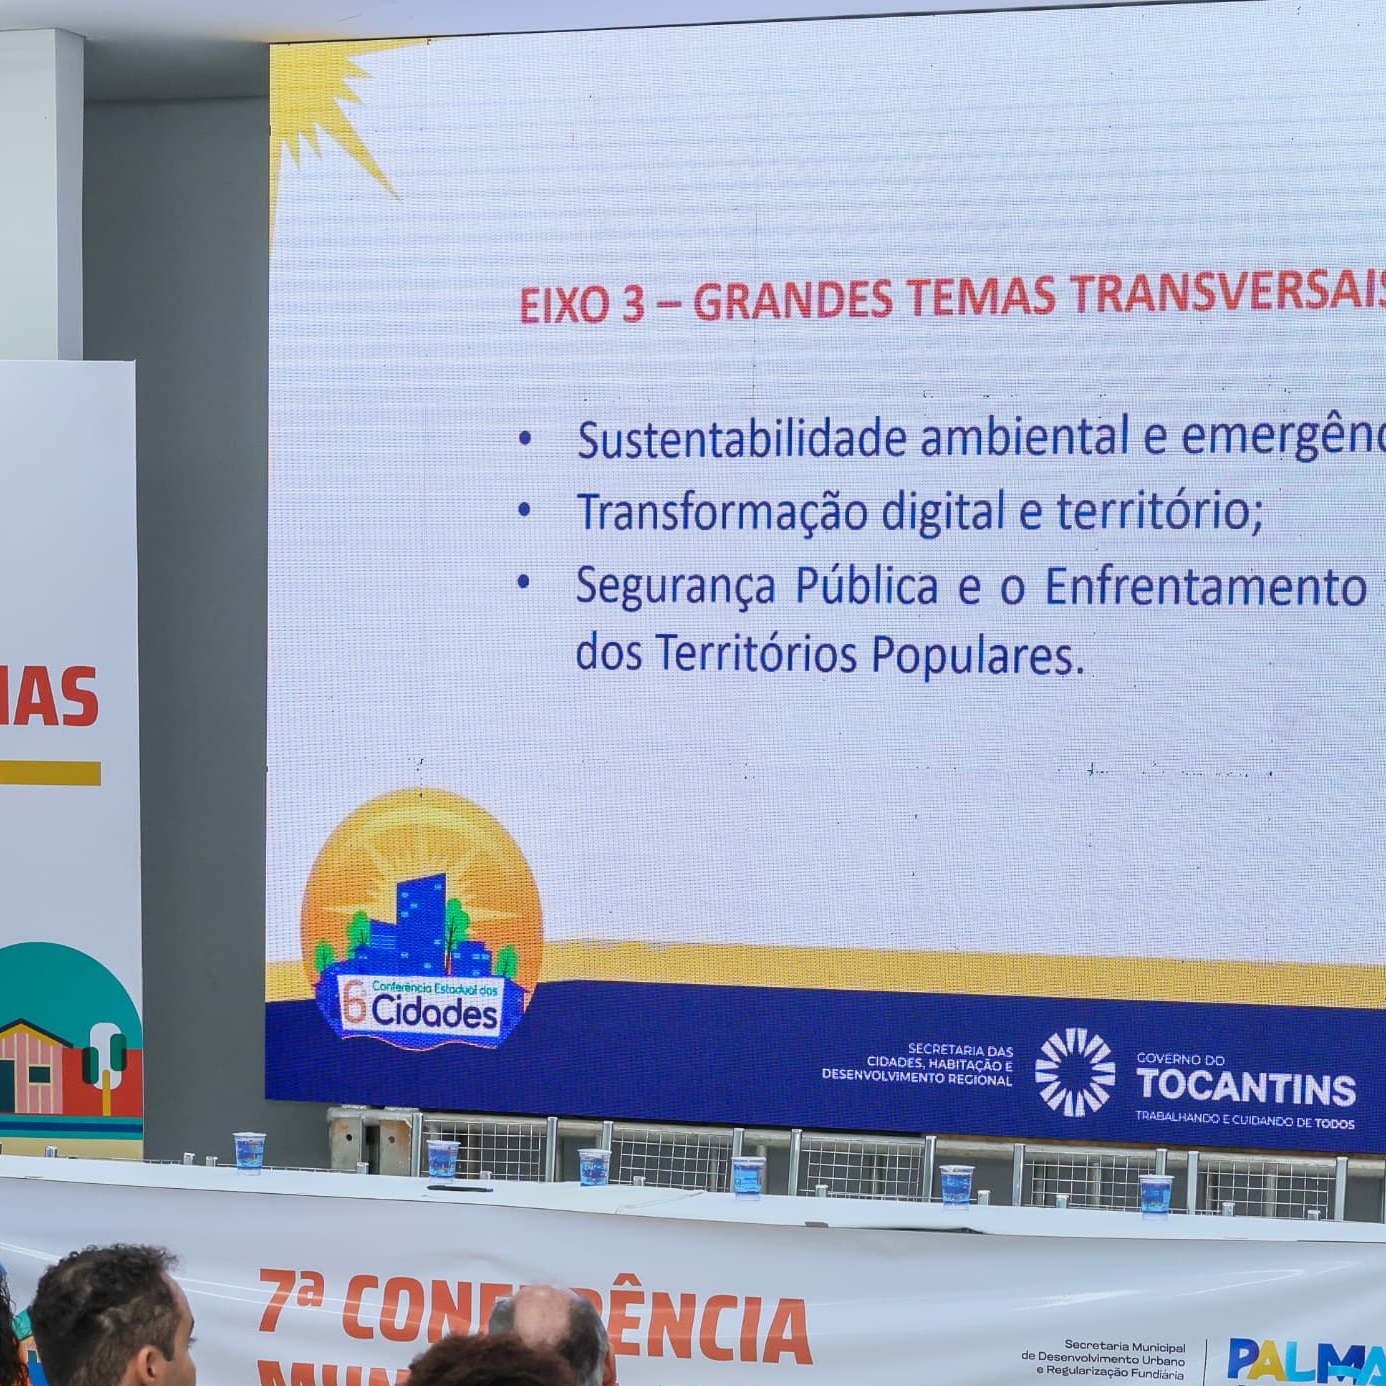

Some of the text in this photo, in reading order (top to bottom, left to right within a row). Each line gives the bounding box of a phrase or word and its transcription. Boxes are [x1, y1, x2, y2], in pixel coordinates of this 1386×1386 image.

[520, 286, 610, 324] EIXO
[623, 284, 645, 323] 3
[693, 279, 893, 321] GRANDES
[907, 275, 1056, 316] TEMAS
[578, 416, 907, 459] Sustentabilidade
[921, 413, 1129, 456] ambiental
[1144, 424, 1168, 454] e
[576, 487, 1263, 540] Transformação digital e território;
[577, 565, 775, 613] Segurança
[797, 563, 938, 605] Pública
[959, 574, 981, 605] e
[1001, 575, 1025, 606] o
[1047, 562, 1367, 607] Enfrentamento
[576, 630, 1084, 683] dos Territórios Populares.
[435, 982, 478, 995] Estadual
[480, 985, 498, 996] dos
[372, 993, 498, 1030] Cidades
[909, 1043, 1013, 1057] SECRETARIA DAS
[1137, 1053, 1225, 1066] GOVERNO DO
[867, 1056, 1013, 1072] CIDADES, HABITAÇÃO E
[822, 1068, 1013, 1087] DESENVOLVIMENTO REGIONAL
[1136, 1068, 1356, 1107] TOCANTINS
[1136, 1110, 1355, 1130] TRABALHANDO E CUIDANDO DE TODOS
[258, 1268, 324, 1333] 7ª
[1065, 1340, 1186, 1355] Secretaria Municipal
[1021, 1350, 1185, 1367] de Desenvolvimento Urbano
[1037, 1365, 1185, 1381] e Regularização Fundiária
